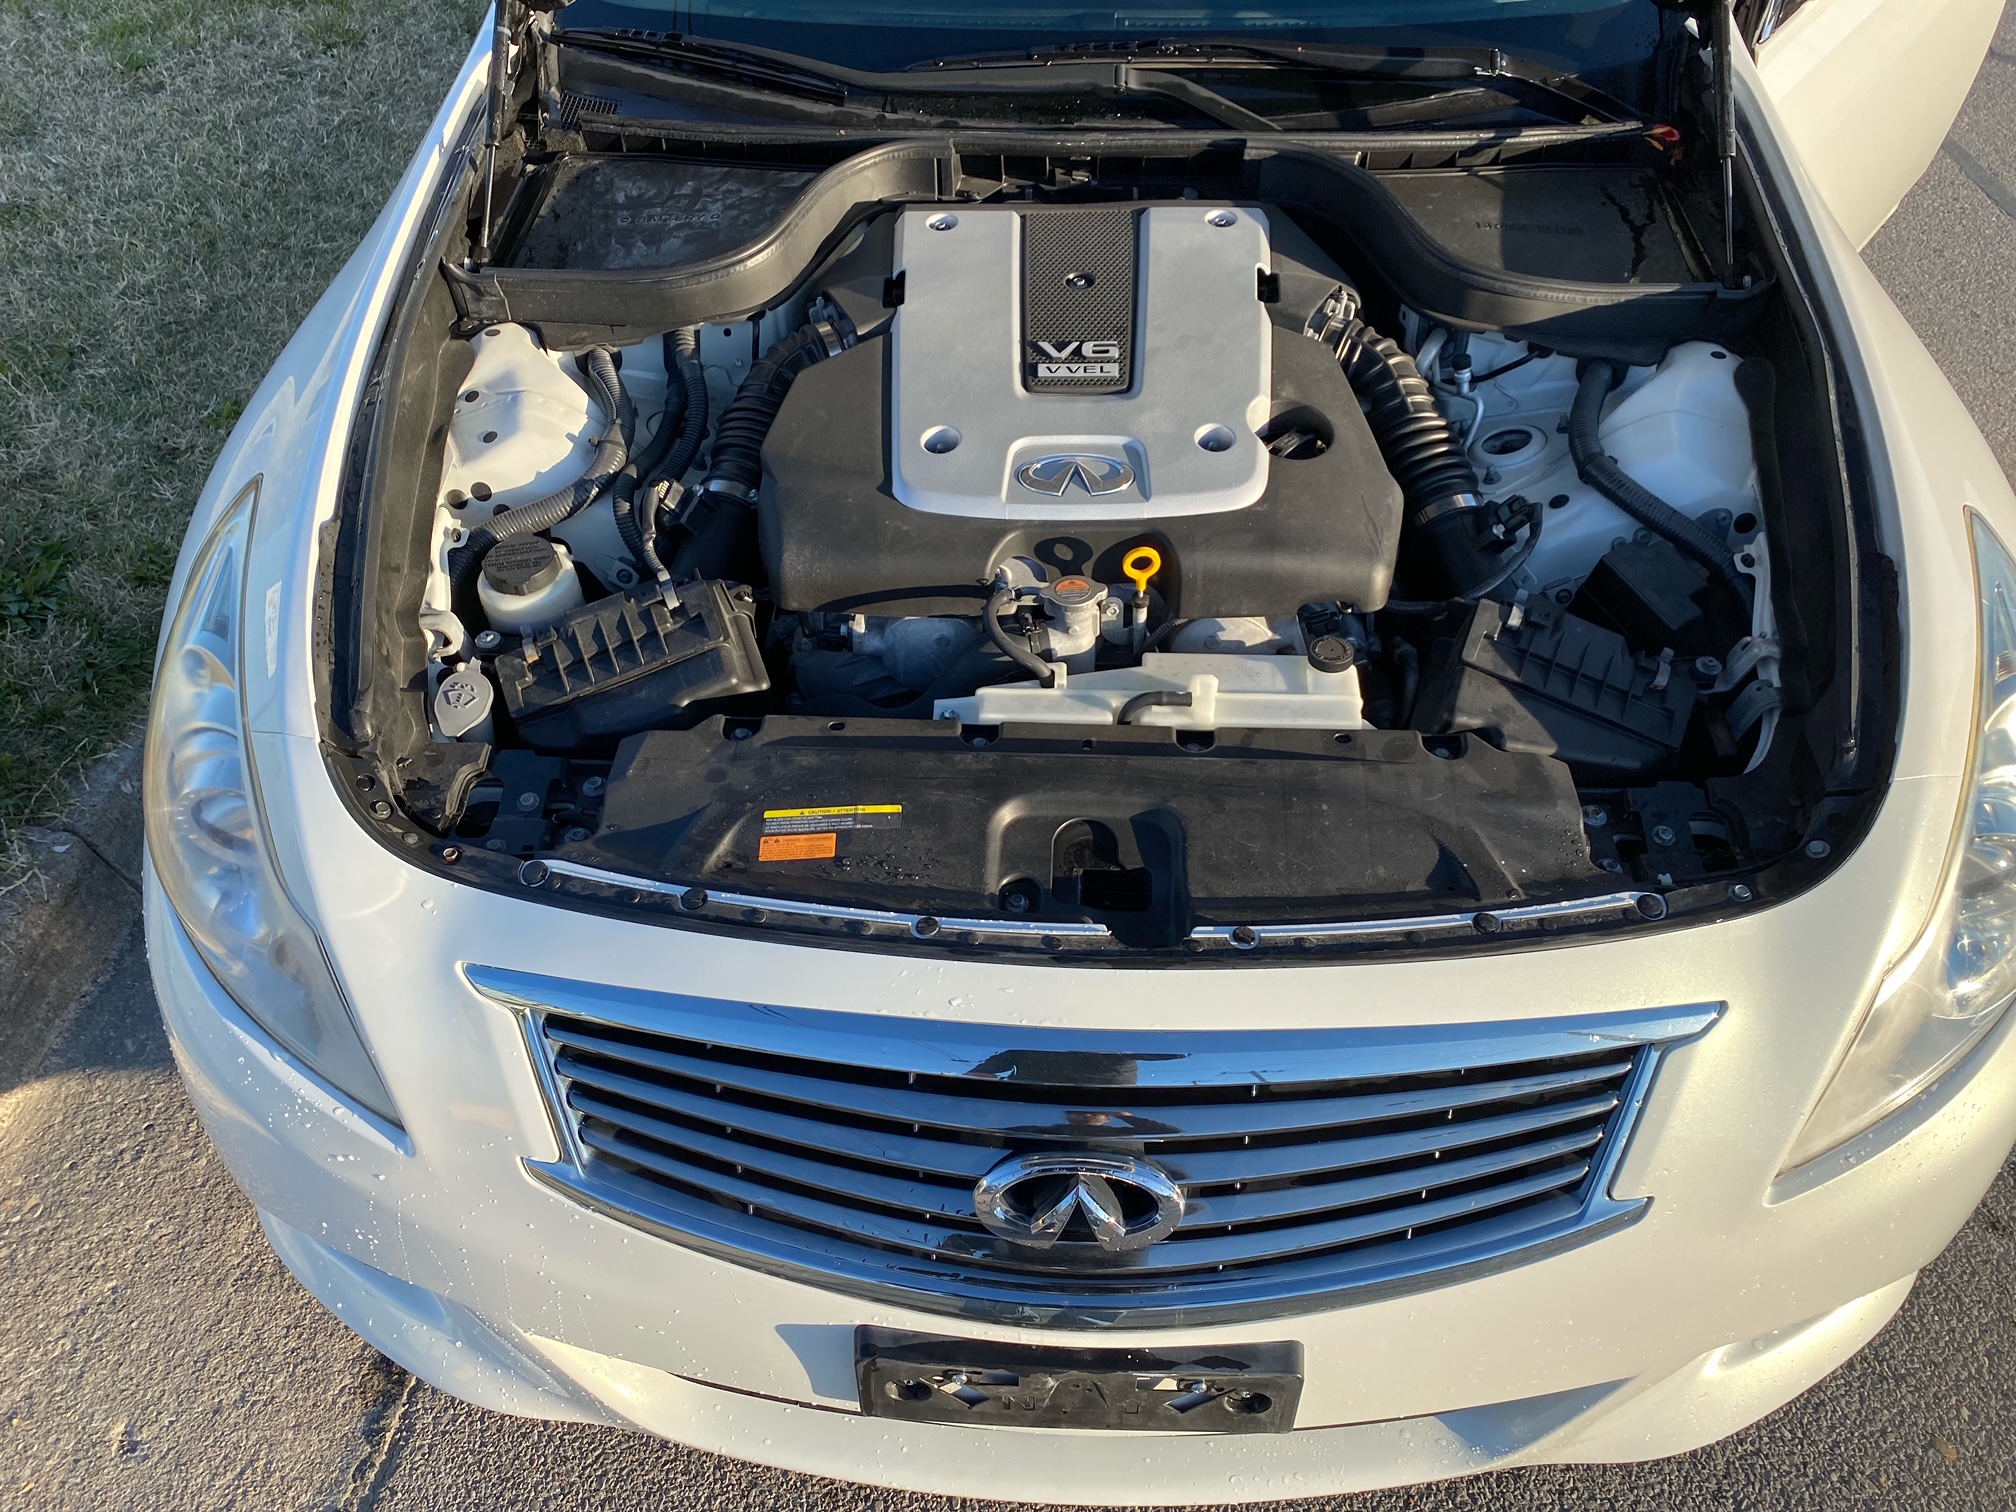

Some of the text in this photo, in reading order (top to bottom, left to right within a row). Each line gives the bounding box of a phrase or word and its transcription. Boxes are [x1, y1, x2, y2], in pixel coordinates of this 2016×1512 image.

[635, 213, 706, 224] BATTERY
[1036, 341, 1120, 360] V6
[1045, 365, 1112, 374] VVEL
